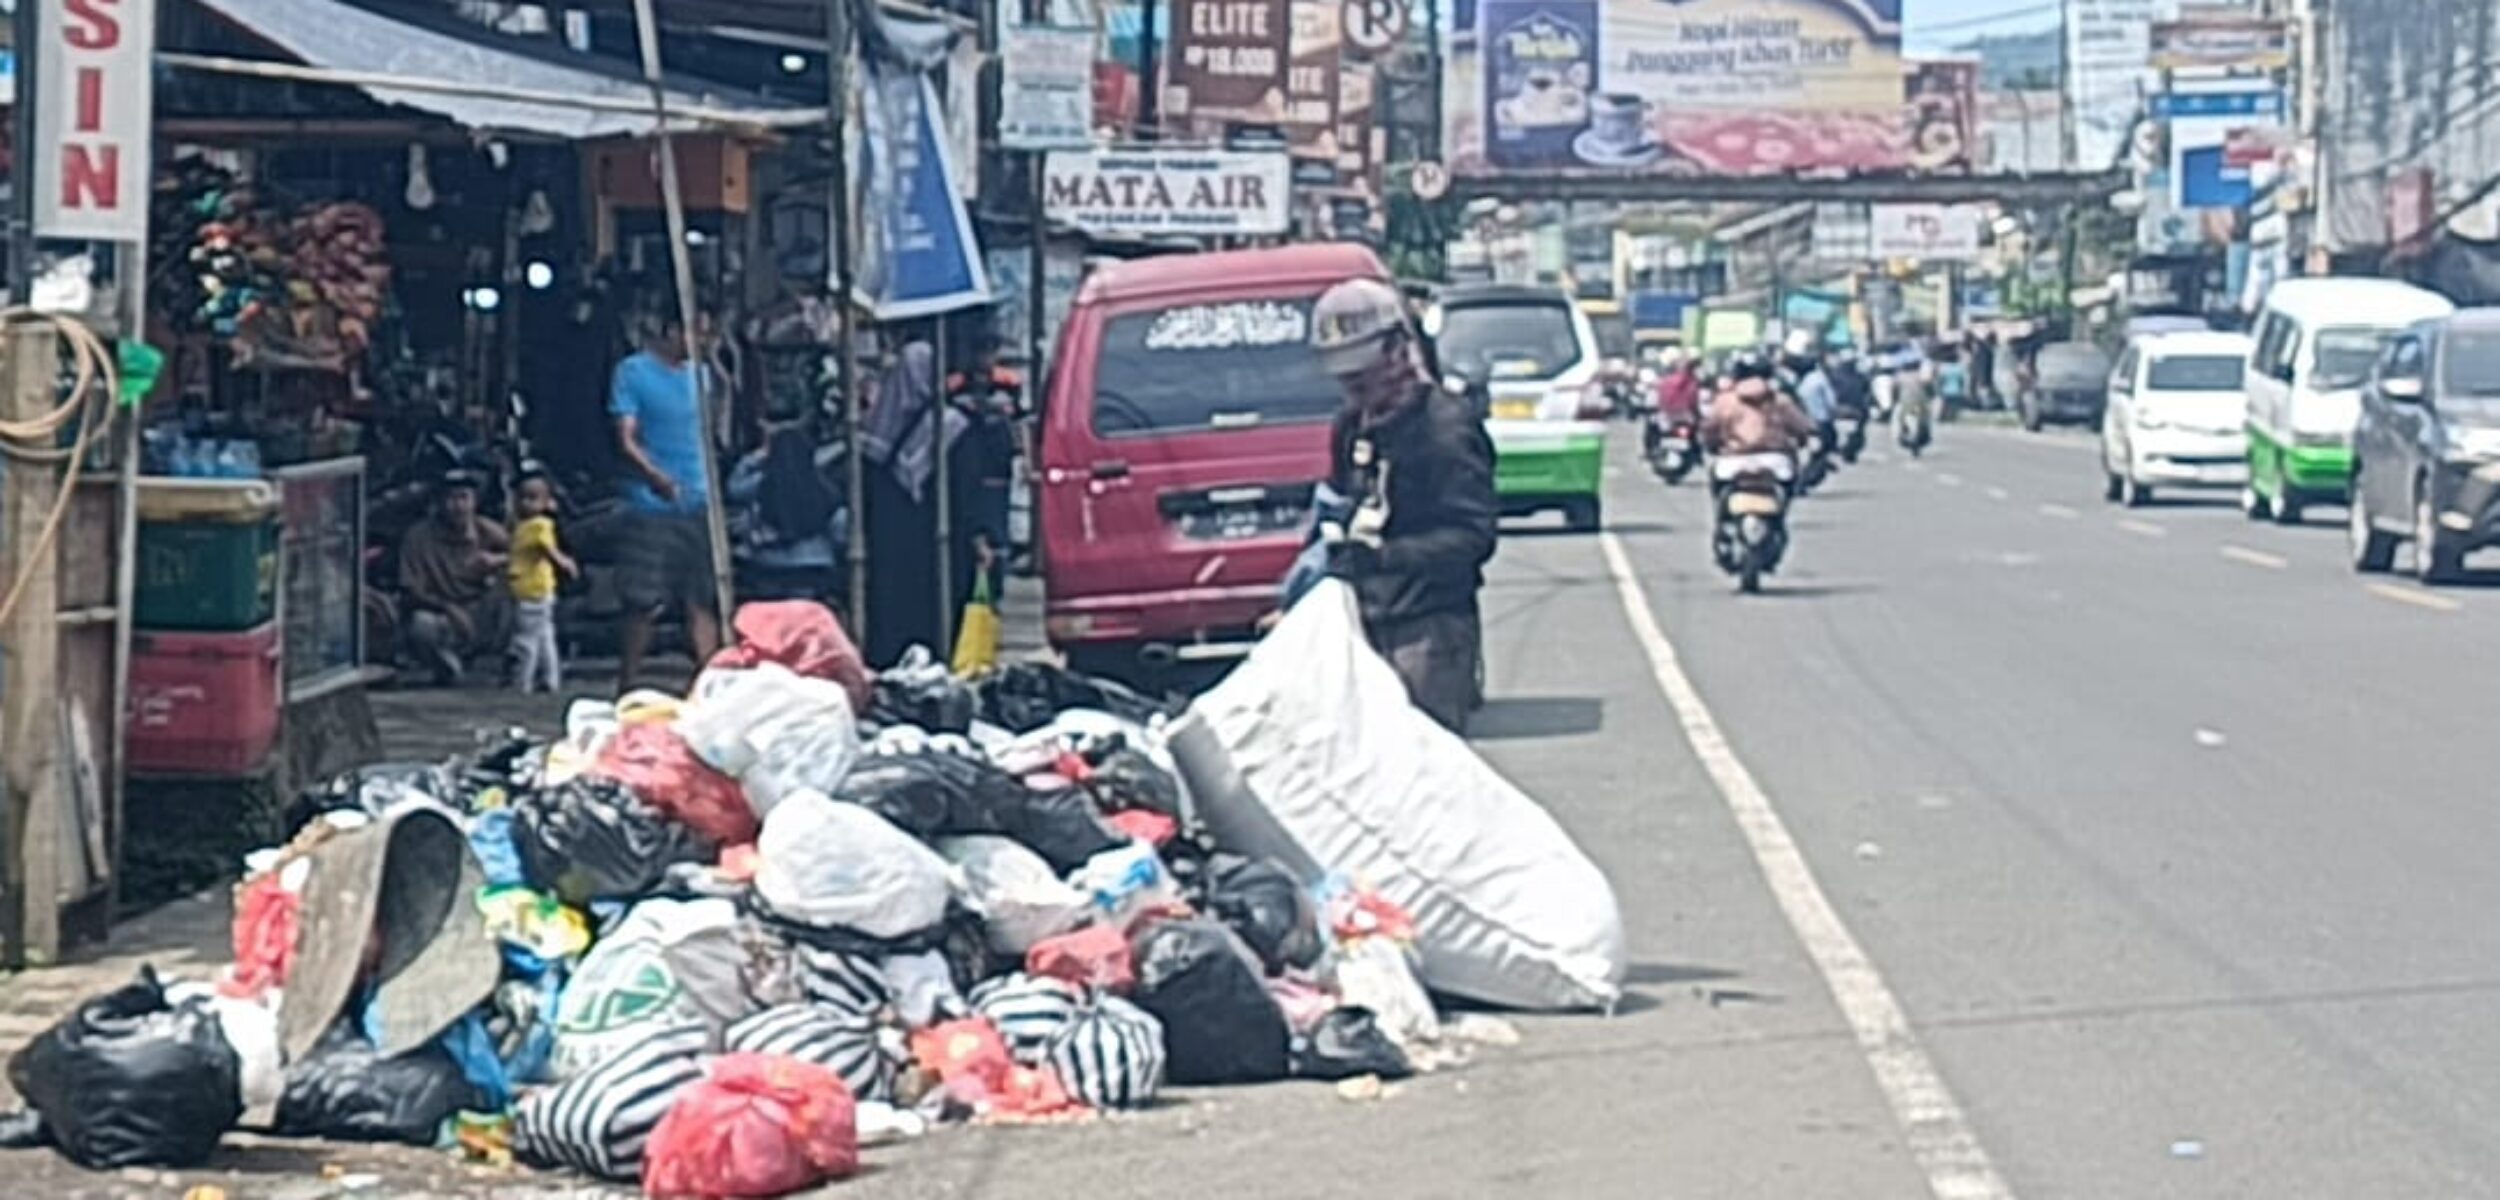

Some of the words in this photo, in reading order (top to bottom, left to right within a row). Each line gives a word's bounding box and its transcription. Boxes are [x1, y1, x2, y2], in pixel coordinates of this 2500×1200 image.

[1191, 2, 1269, 36] ELITE
[1048, 172, 1174, 209] MATA
[1187, 174, 1268, 210] AIR
